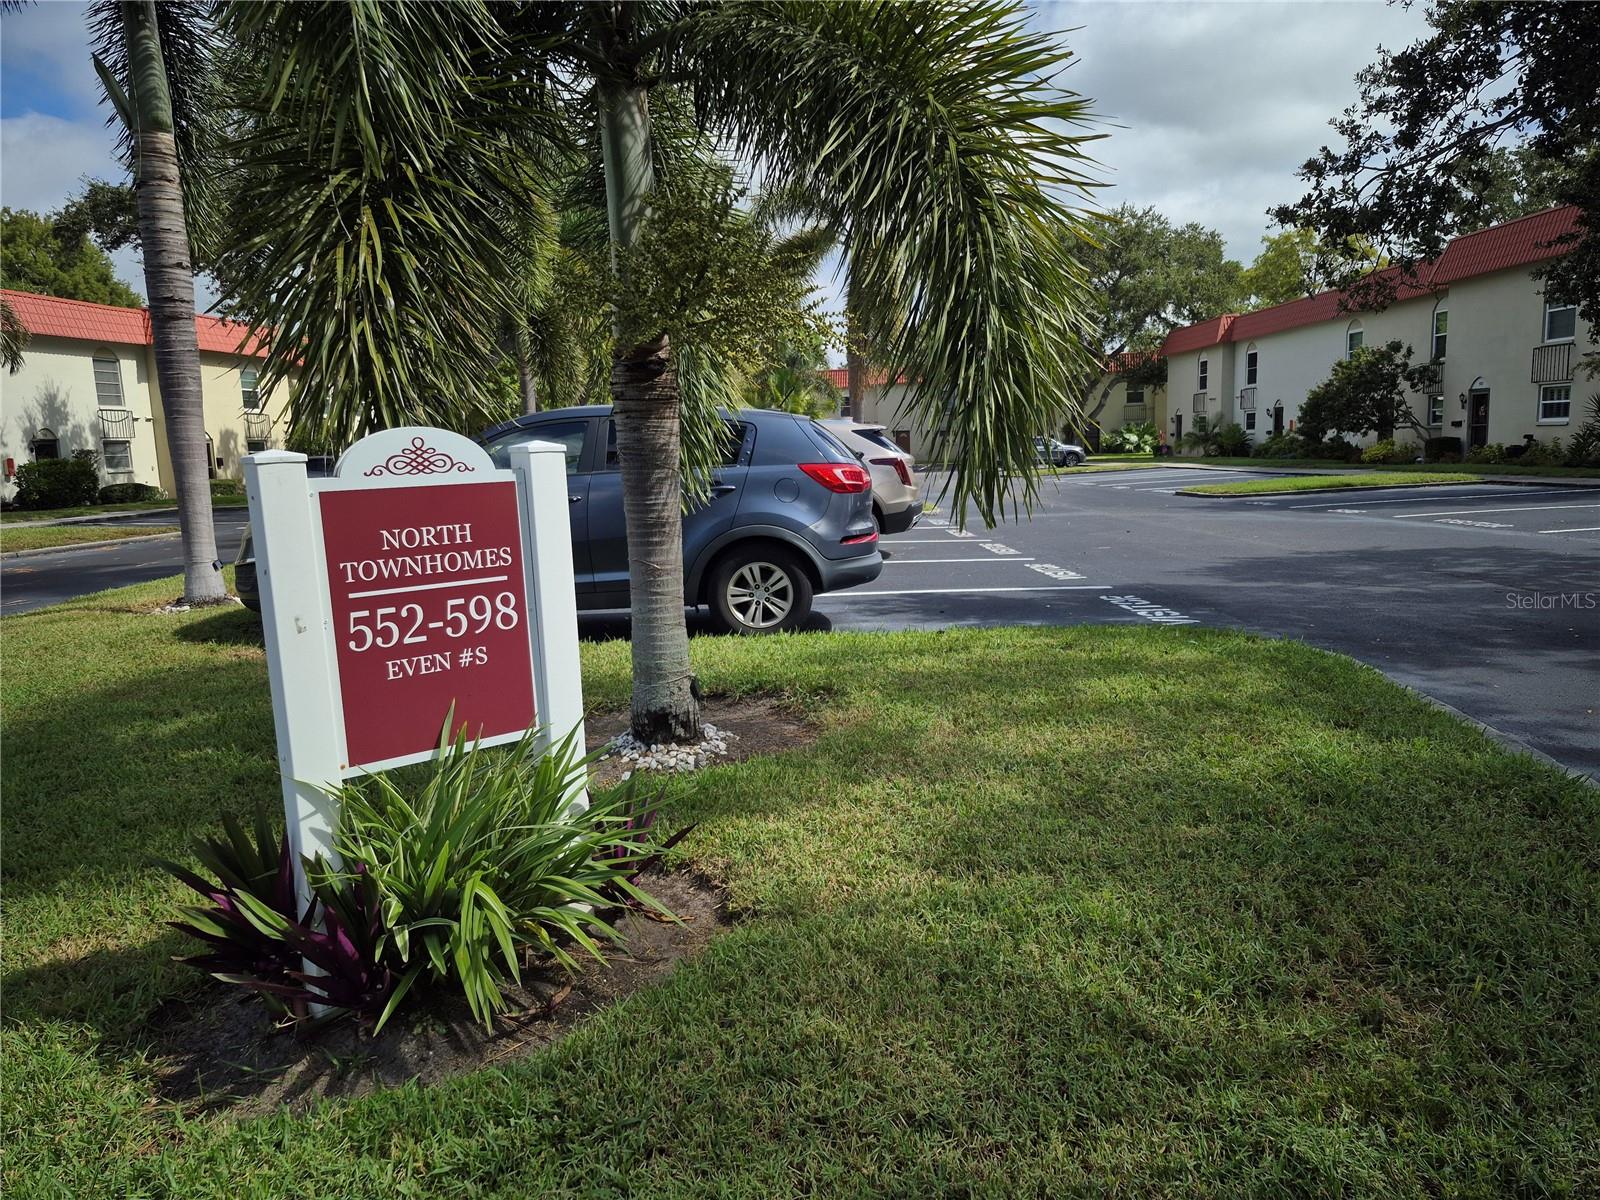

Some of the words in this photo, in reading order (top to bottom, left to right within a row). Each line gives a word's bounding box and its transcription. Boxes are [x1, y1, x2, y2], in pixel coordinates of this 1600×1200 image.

[380, 523, 473, 550] NORTH
[339, 546, 513, 583] TOWNHOMES
[348, 591, 519, 652] 552-598
[1099, 595, 1201, 626] VISITOR
[386, 651, 452, 681] EVEN
[458, 646, 488, 668] #S
